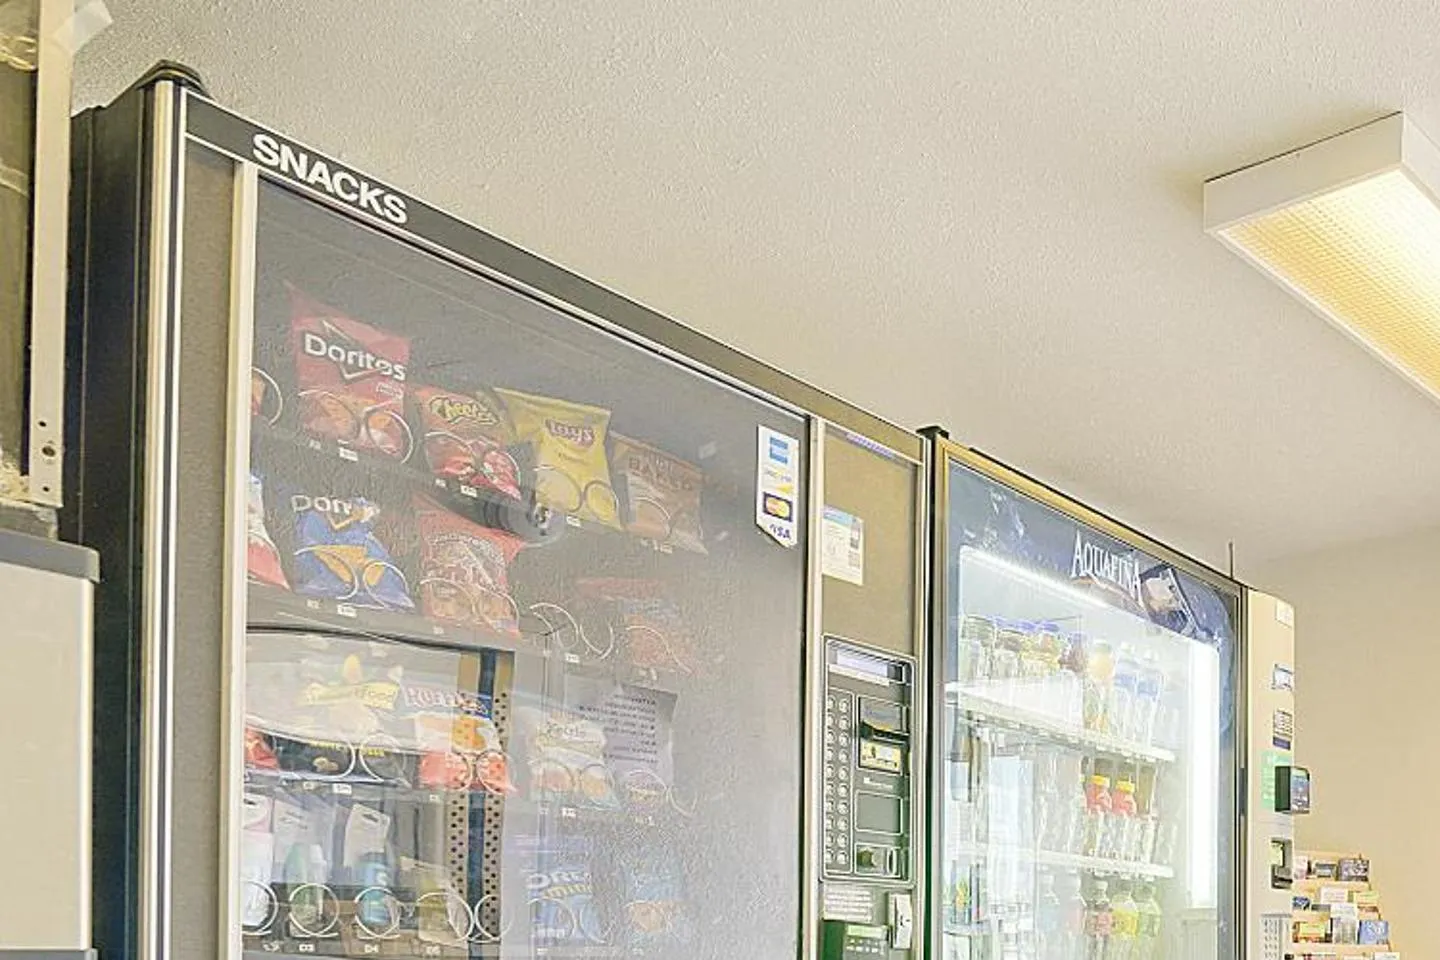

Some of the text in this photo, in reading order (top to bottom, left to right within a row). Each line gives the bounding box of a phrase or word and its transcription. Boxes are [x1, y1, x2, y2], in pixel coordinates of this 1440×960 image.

[253, 133, 408, 224] SNACKS
[304, 332, 408, 381] Doritos
[769, 523, 792, 540] VISA
